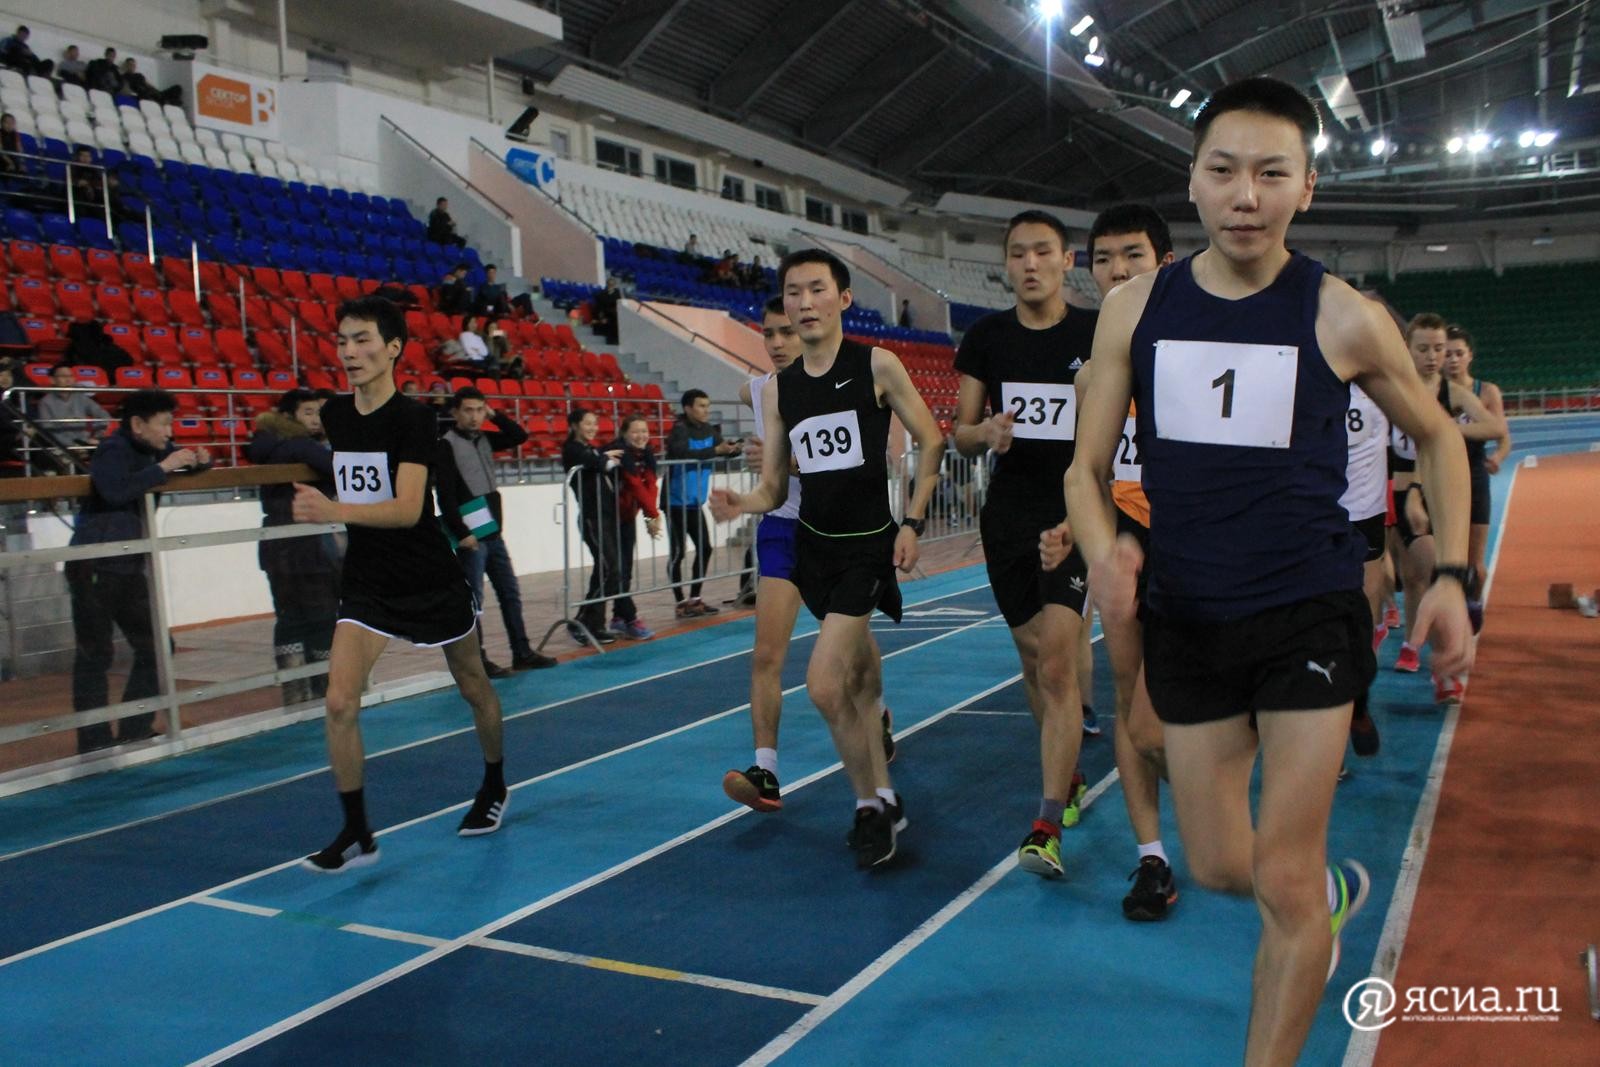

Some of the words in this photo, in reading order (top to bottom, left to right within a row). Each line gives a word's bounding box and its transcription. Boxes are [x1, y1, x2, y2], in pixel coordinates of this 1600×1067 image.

[1211, 367, 1236, 419] 1
[1010, 396, 1067, 425] 237
[800, 426, 852, 459] 139
[338, 465, 381, 492] 153
